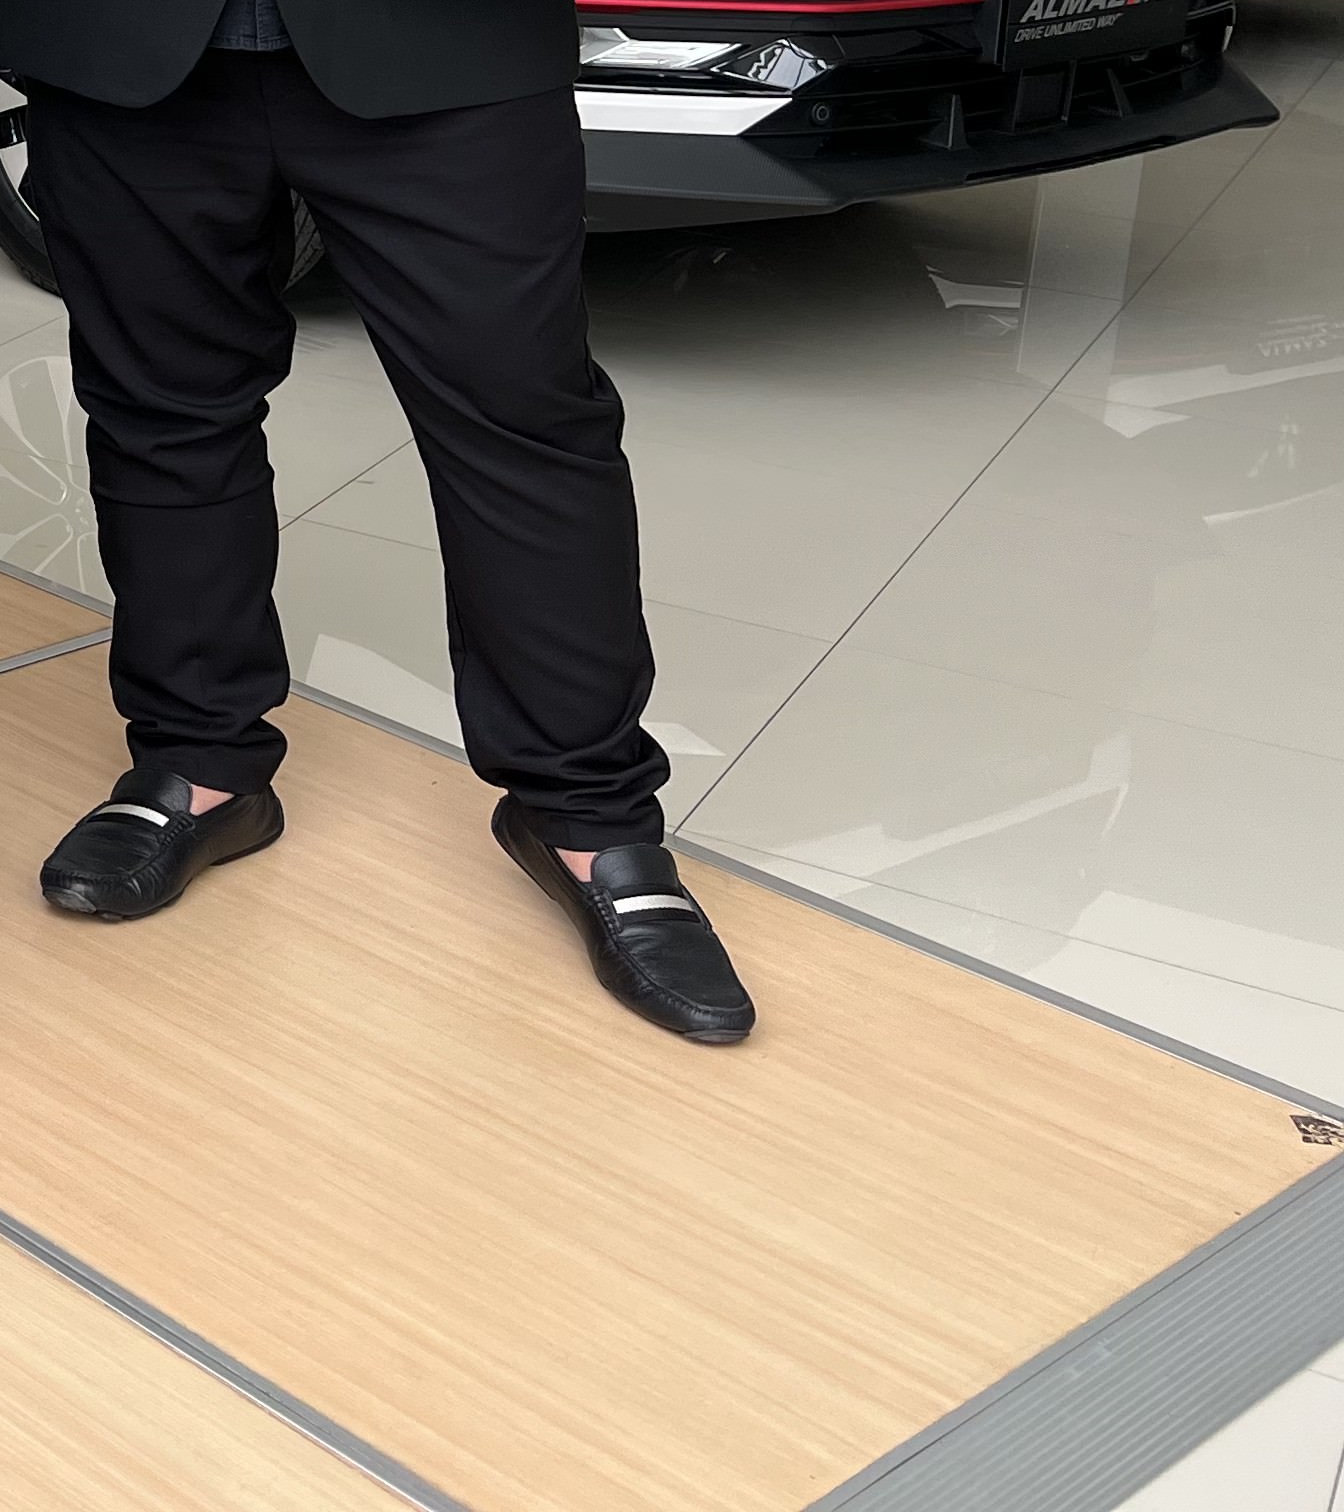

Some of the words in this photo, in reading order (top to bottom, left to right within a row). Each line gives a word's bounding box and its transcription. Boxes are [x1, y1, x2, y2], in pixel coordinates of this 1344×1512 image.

[1014, 25, 1046, 43] DRIVE
[1043, 17, 1096, 38] UNLIMITED
[1096, 13, 1125, 30] WAY
